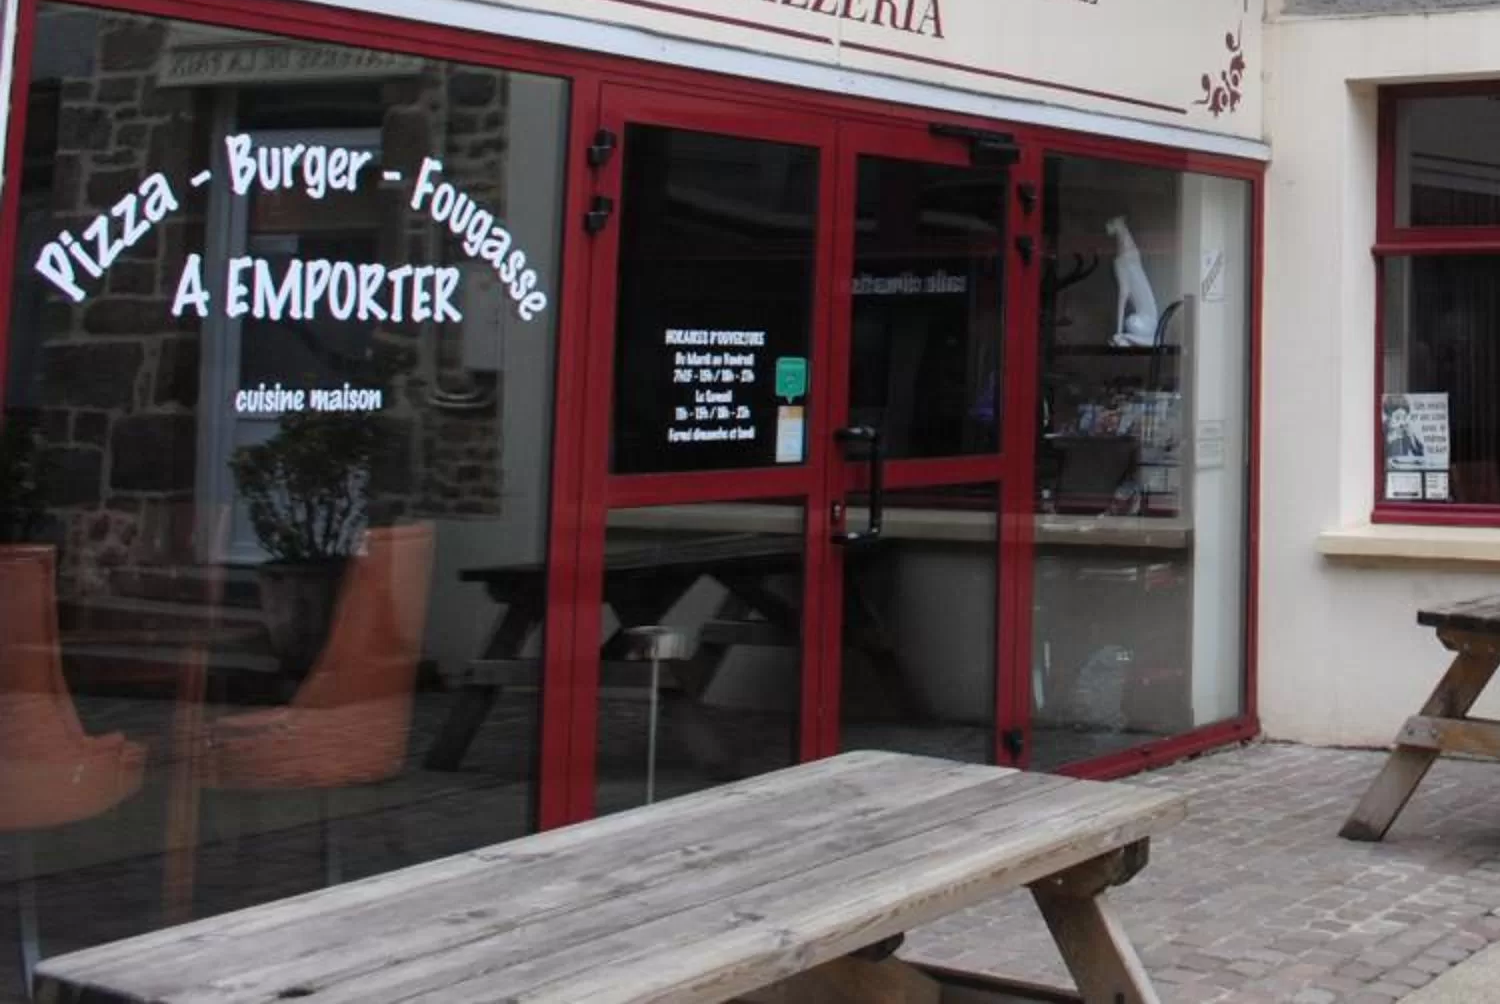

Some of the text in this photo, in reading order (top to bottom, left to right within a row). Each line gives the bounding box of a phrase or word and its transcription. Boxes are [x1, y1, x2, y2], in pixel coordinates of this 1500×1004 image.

[35, 171, 180, 303] Pizza
[225, 132, 372, 199] Burger
[410, 156, 548, 322] Fougasse
[171, 253, 463, 323] A EMPORTER
[235, 383, 381, 412] cuisine maison
